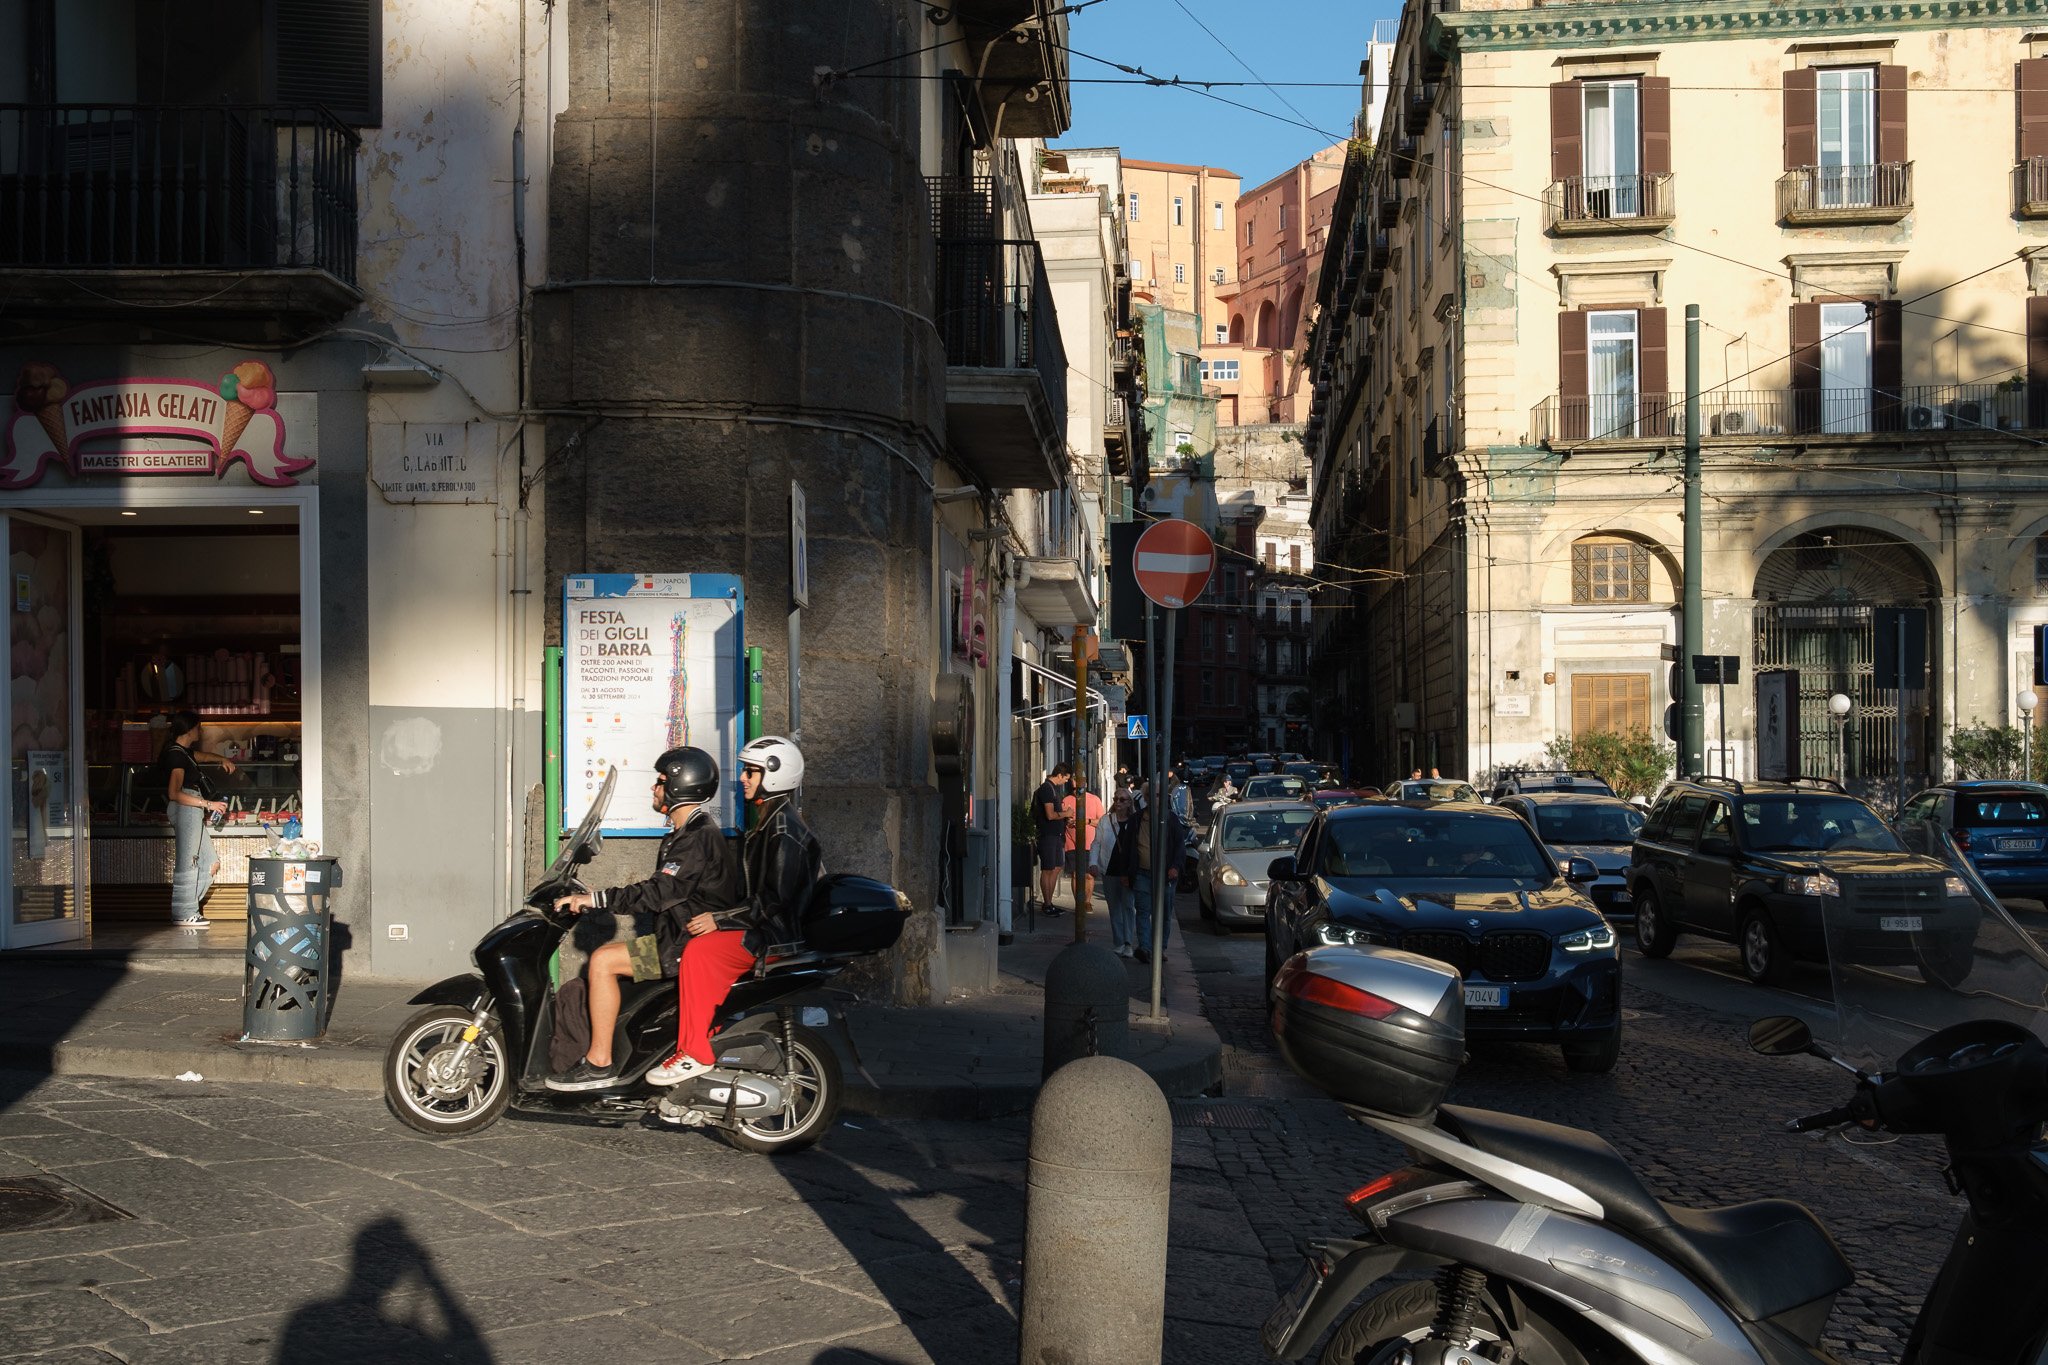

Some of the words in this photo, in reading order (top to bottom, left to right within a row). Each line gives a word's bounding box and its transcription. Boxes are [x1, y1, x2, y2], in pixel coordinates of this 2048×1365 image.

[71, 393, 152, 426] FANTASIA
[157, 393, 218, 425] GELATI
[425, 433, 444, 446] VIA
[83, 455, 139, 468] MAESTRI
[143, 455, 207, 467] GELATIERI
[580, 611, 625, 624] FESTA
[580, 629, 599, 640] DEI
[604, 627, 648, 640] GIGLI
[580, 645, 592, 656] DI
[598, 643, 652, 656] BARRA
[1895, 919, 1908, 928] 958
